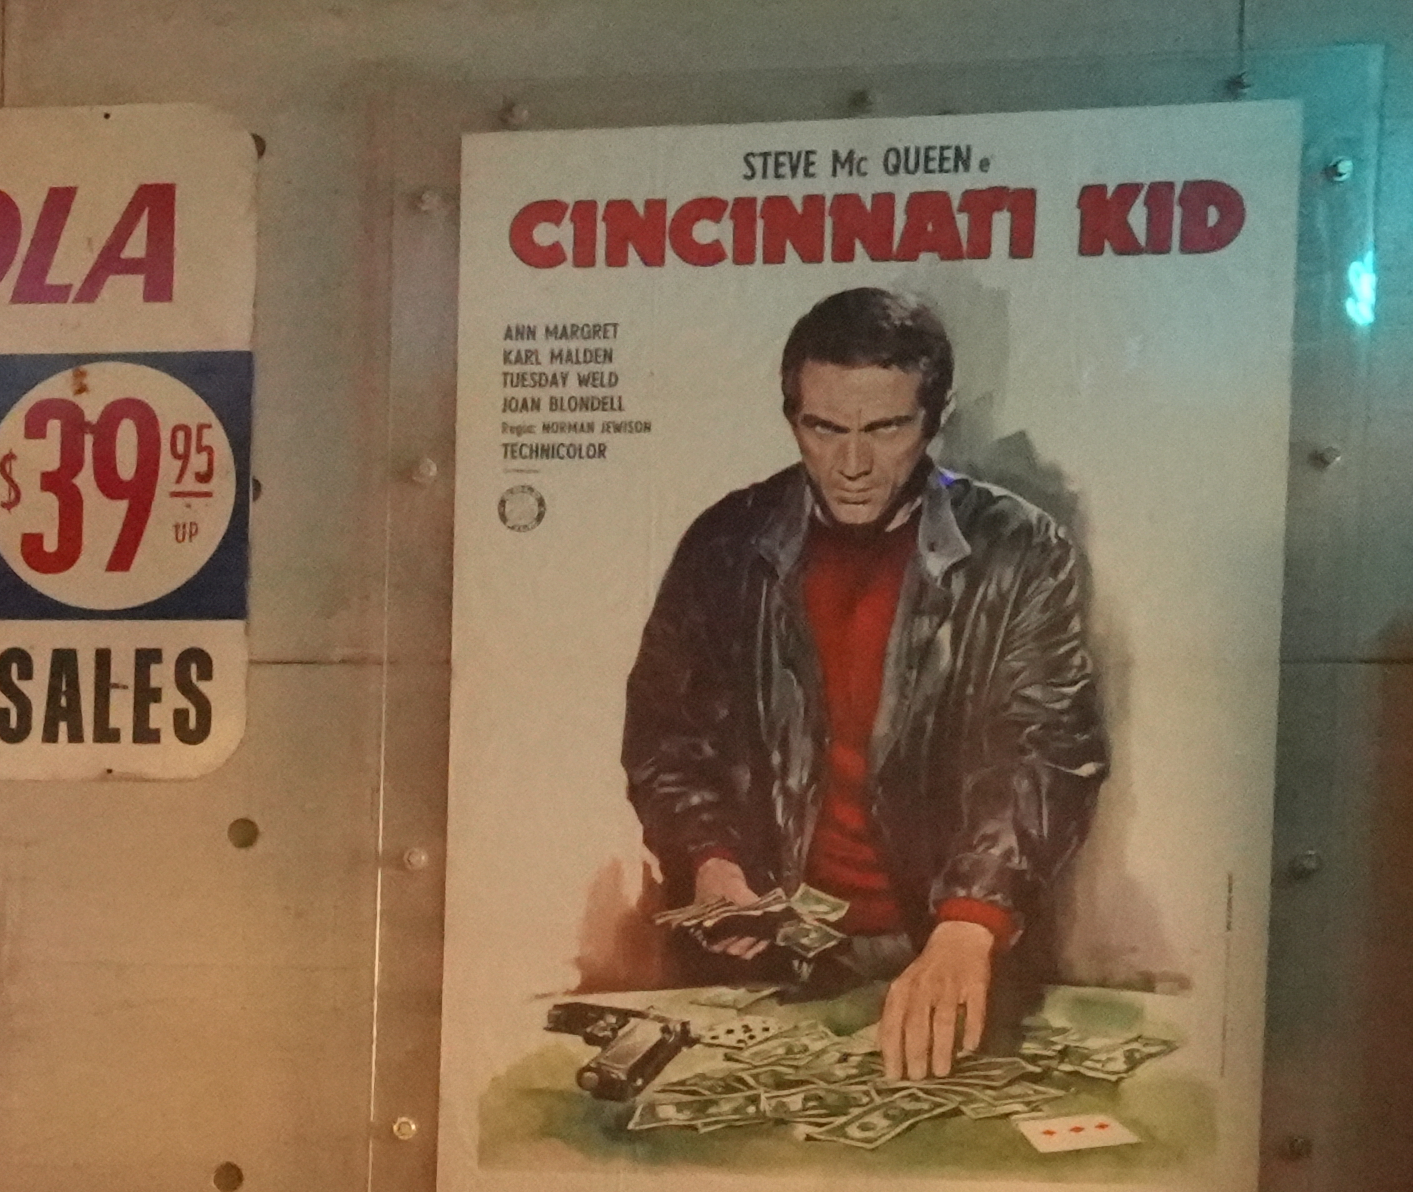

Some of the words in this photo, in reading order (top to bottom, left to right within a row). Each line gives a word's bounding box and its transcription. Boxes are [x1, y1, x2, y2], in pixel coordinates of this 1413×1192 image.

[743, 150, 817, 180] STEVE
[831, 149, 869, 178] Mc
[882, 144, 972, 176] QUEEN
[508, 185, 1038, 269] CINCINNATI
[1077, 179, 1246, 257] KID
[503, 324, 537, 341] ANN
[544, 323, 619, 340] MARGRET
[502, 348, 542, 365] KARL
[549, 348, 613, 365] MALDEN
[502, 371, 569, 388] TUESDAY
[576, 371, 619, 388] WELD
[501, 397, 541, 414] JOAN
[548, 396, 625, 412] BLONDELL
[542, 421, 595, 434] NORMAN
[601, 421, 652, 434] JEWISON
[502, 442, 608, 460] TECHNICOLOR
[174, 521, 199, 544] UP
